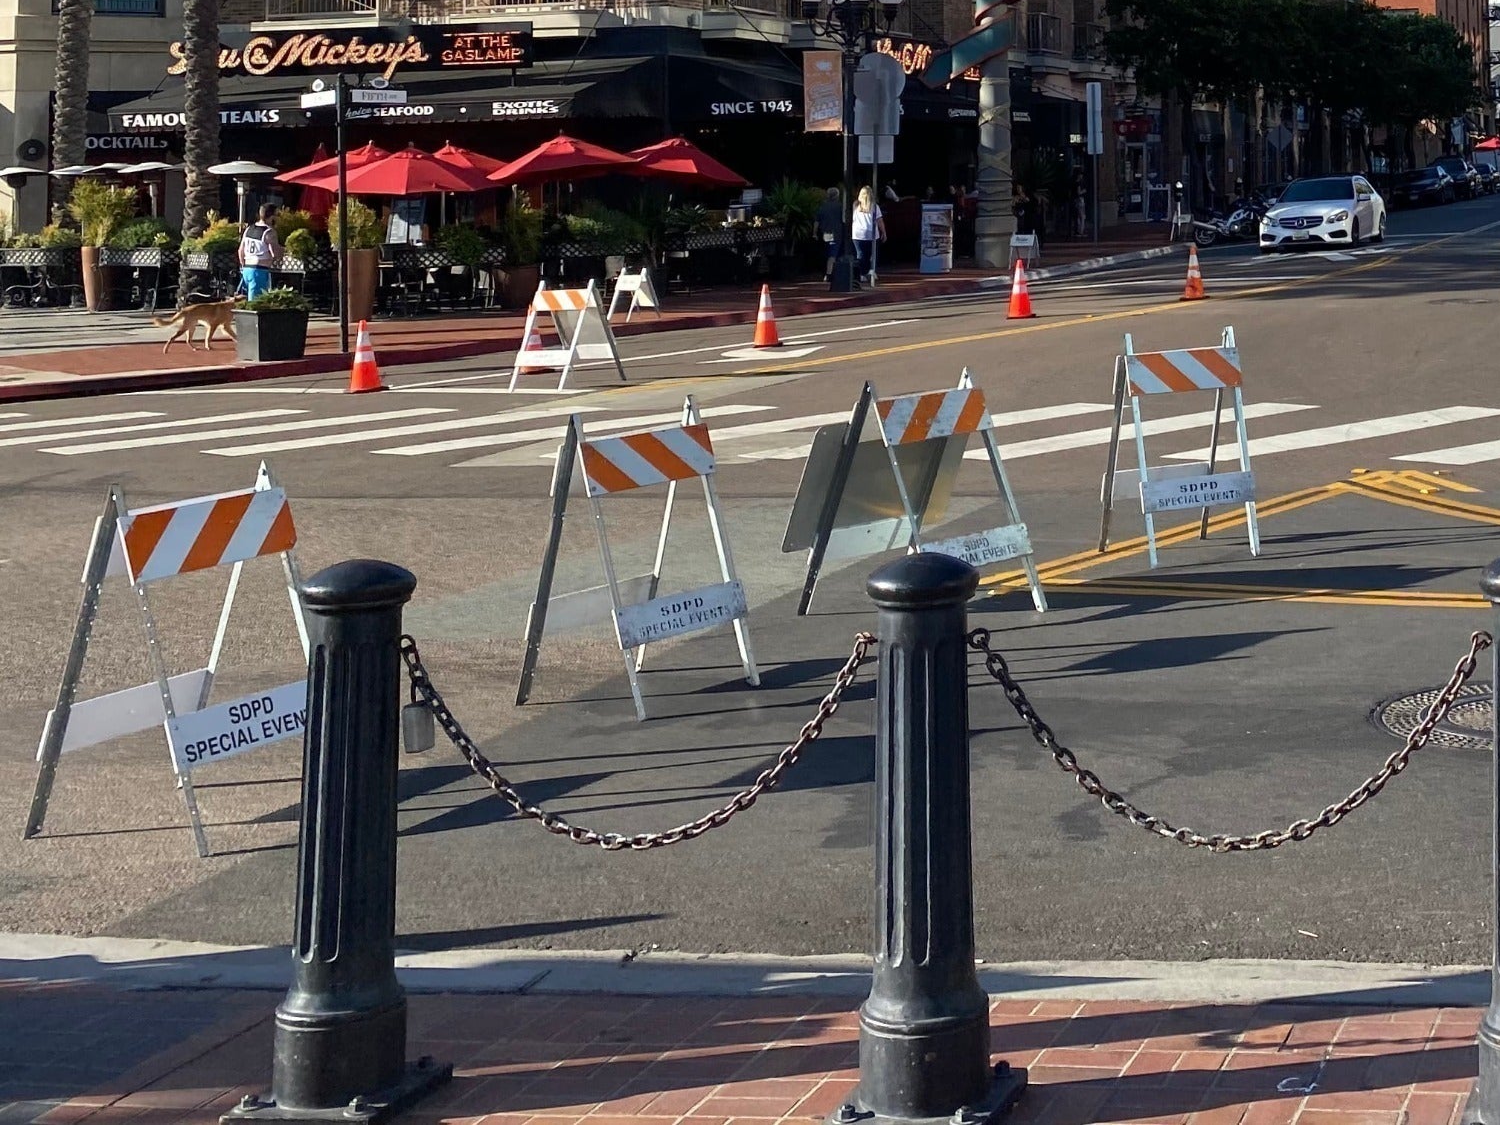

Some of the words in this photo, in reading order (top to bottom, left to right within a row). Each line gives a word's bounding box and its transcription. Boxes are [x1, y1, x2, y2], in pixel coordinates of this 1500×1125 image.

[454, 36, 474, 48] AT
[479, 35, 511, 48] THE
[275, 33, 429, 81] Mickey's
[441, 47, 523, 63] GASLAMP
[362, 91, 388, 101] FIFTH
[345, 107, 374, 120] hoice
[373, 105, 434, 117] SEAFOOD
[492, 100, 554, 109] EXOTIC
[492, 107, 560, 116] DRINKS
[711, 101, 756, 115] SINCE
[760, 99, 793, 113] 1945
[122, 113, 187, 128] FAMOU
[219, 108, 280, 124] TEAKS
[84, 136, 169, 150] OCKTAILS
[1179, 481, 1219, 493] SDPD
[1158, 494, 1201, 508] SPECIAL
[1203, 490, 1241, 503] EVENTS
[963, 537, 990, 552] SDPD
[983, 543, 1019, 561] EVENTS
[660, 597, 704, 617] SDPD
[639, 617, 686, 638] SPECIAL
[689, 604, 731, 625] EVENTS
[228, 696, 275, 725] SDPD
[185, 726, 260, 763] SPECIAL
